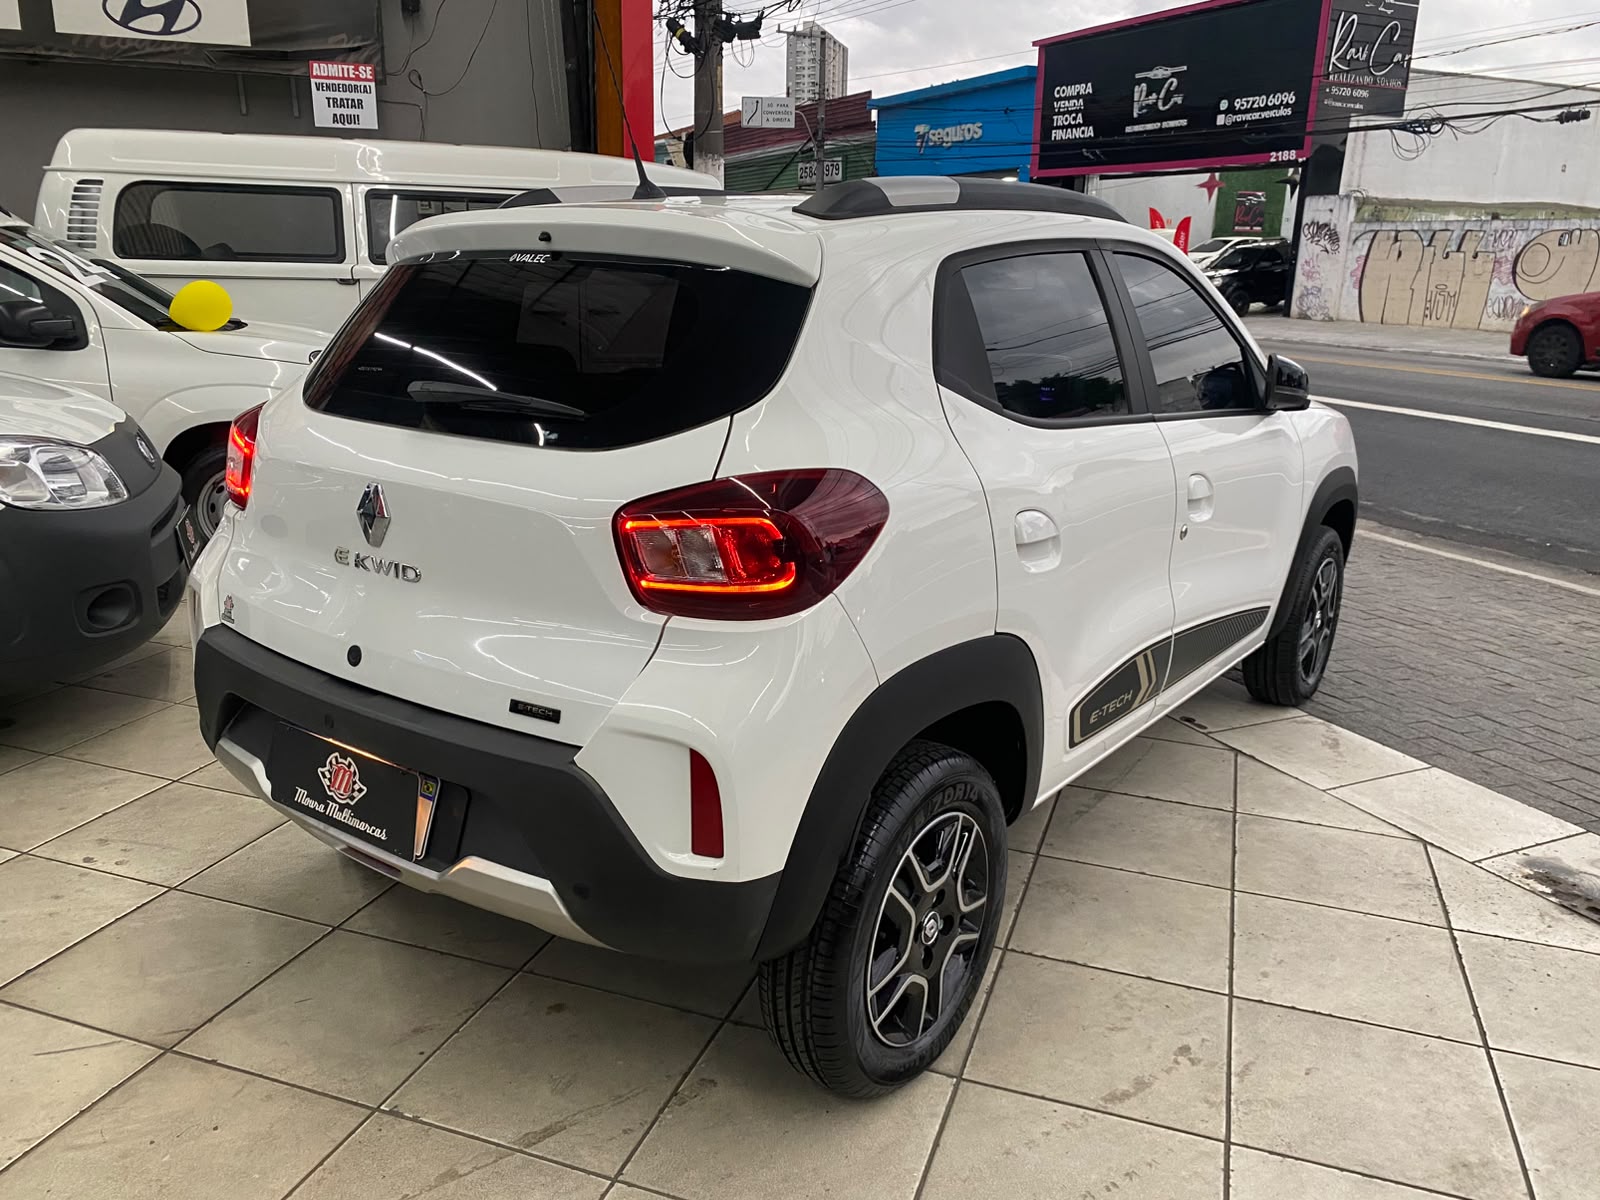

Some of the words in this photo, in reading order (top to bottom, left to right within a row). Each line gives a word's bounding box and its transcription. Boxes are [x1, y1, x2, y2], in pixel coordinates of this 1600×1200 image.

[1369, 20, 1412, 76] Car
[312, 63, 373, 79] ADMITE-SE
[315, 82, 372, 94] VENDEDOR(A)
[1054, 82, 1093, 98] COMPRA
[1330, 86, 1352, 96] 95720
[325, 97, 364, 110] TRATAR
[1053, 98, 1084, 112] VENDA
[1234, 95, 1267, 111] 95720
[1267, 91, 1296, 106] 6096
[332, 113, 361, 126] AQUI!
[1053, 112, 1083, 127] TROCA
[1051, 126, 1094, 141] FINANCIA
[1269, 150, 1296, 162] 2188
[354, 551, 422, 583] KWID
[518, 703, 553, 718] E-TECH
[1089, 690, 1133, 724] E-TECH
[294, 786, 325, 813] Moura
[326, 800, 388, 840] Multimarcas
